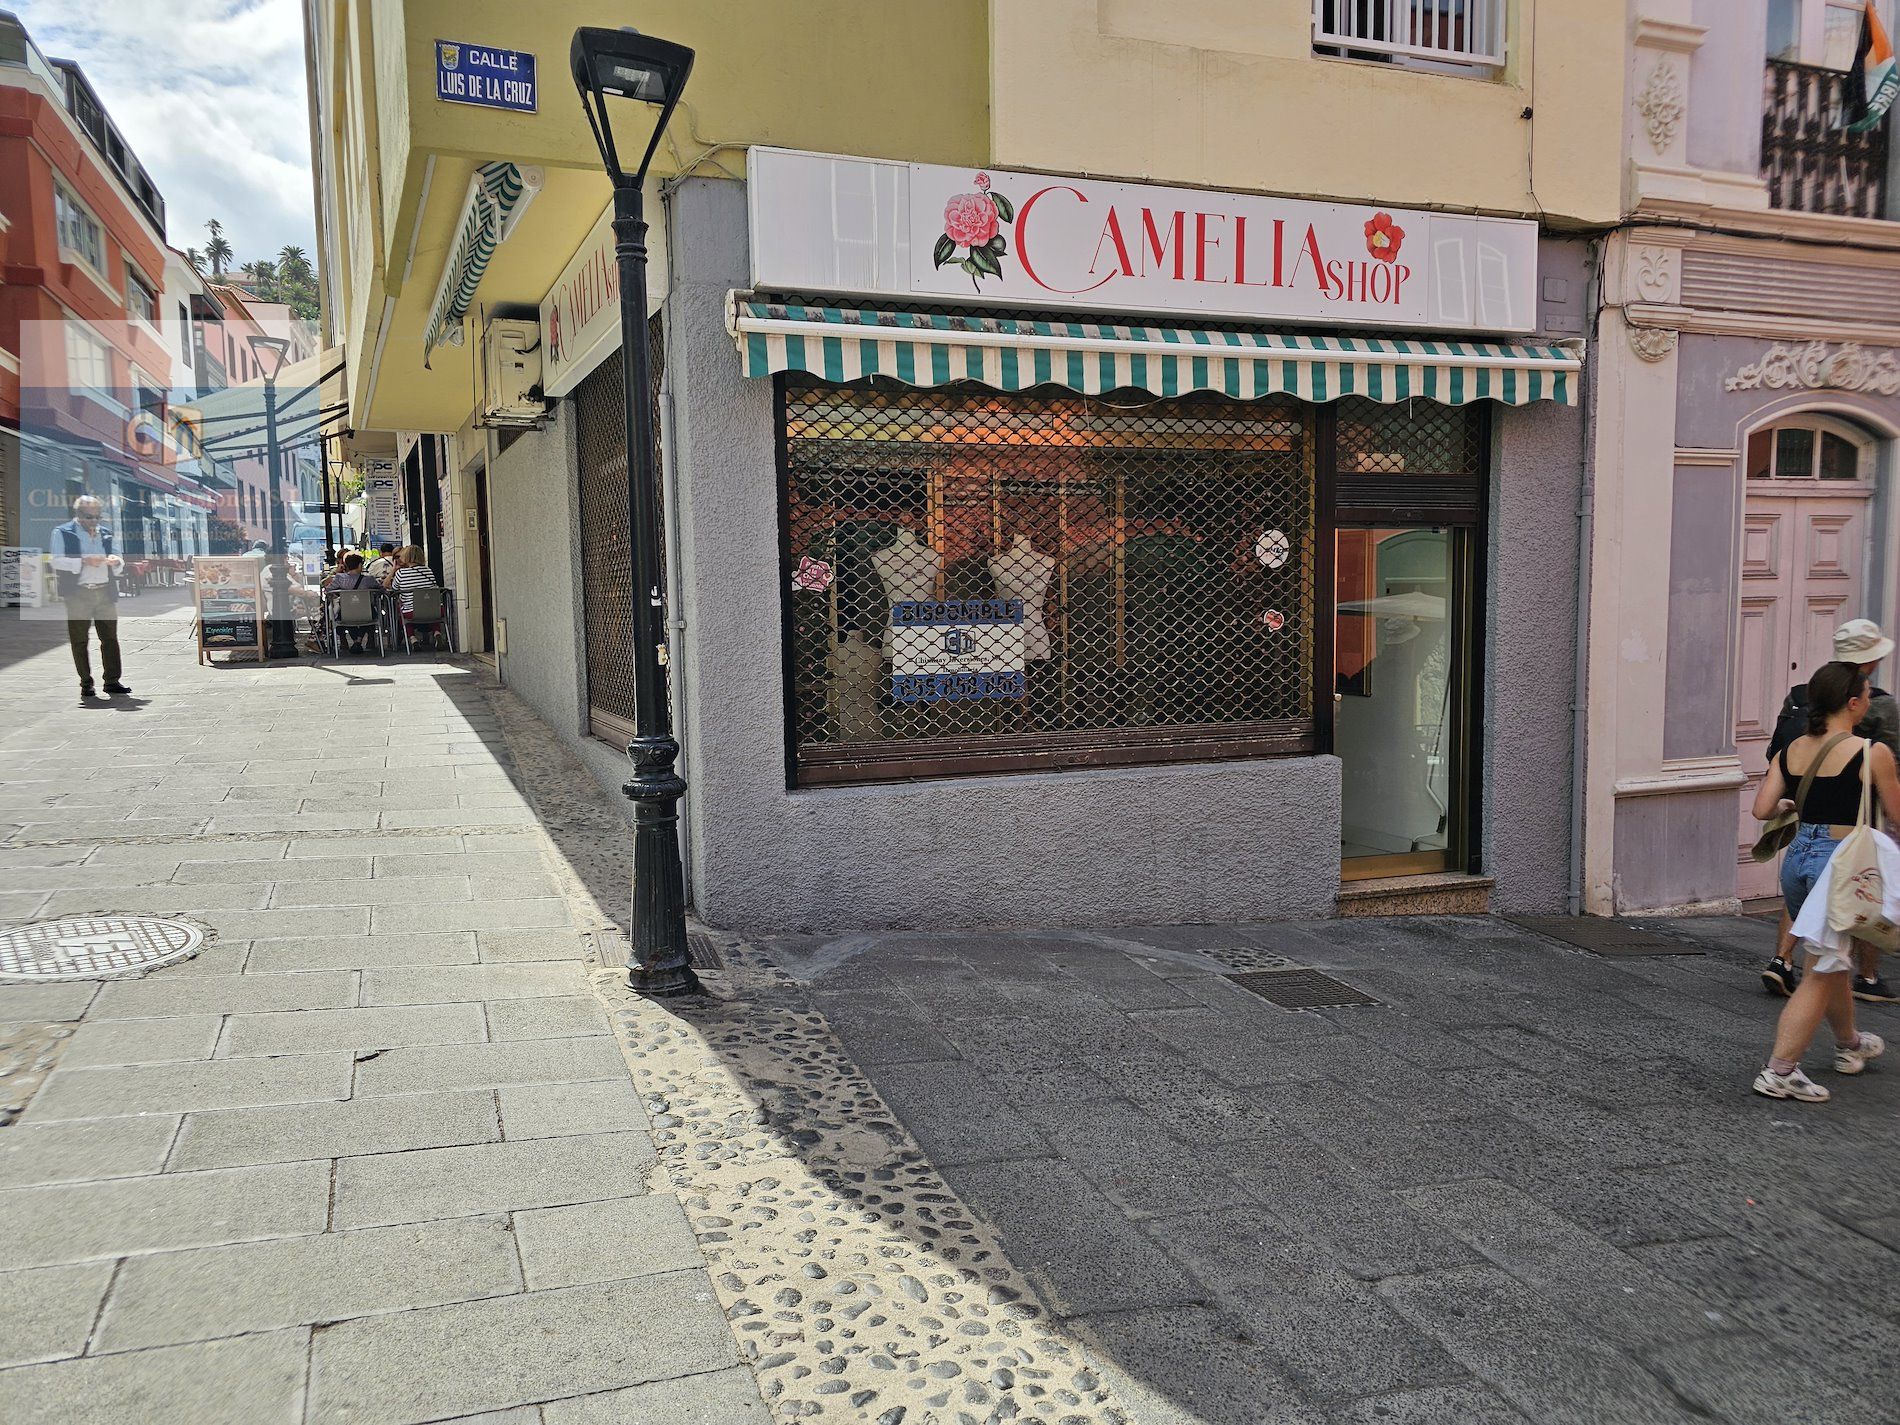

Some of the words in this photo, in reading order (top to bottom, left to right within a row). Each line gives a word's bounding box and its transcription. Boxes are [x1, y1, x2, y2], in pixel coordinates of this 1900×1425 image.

[469, 50, 518, 71] CALLE
[440, 71, 465, 96] LUIS
[468, 74, 483, 98] DE
[486, 77, 501, 101] LA
[504, 80, 533, 105] CRUZ
[1014, 185, 1331, 294] CAMELIA
[1323, 259, 1411, 305] SHOP
[558, 243, 609, 362] CAMELIA
[607, 260, 620, 307] SH
[902, 603, 1016, 621] DISPONIBLE
